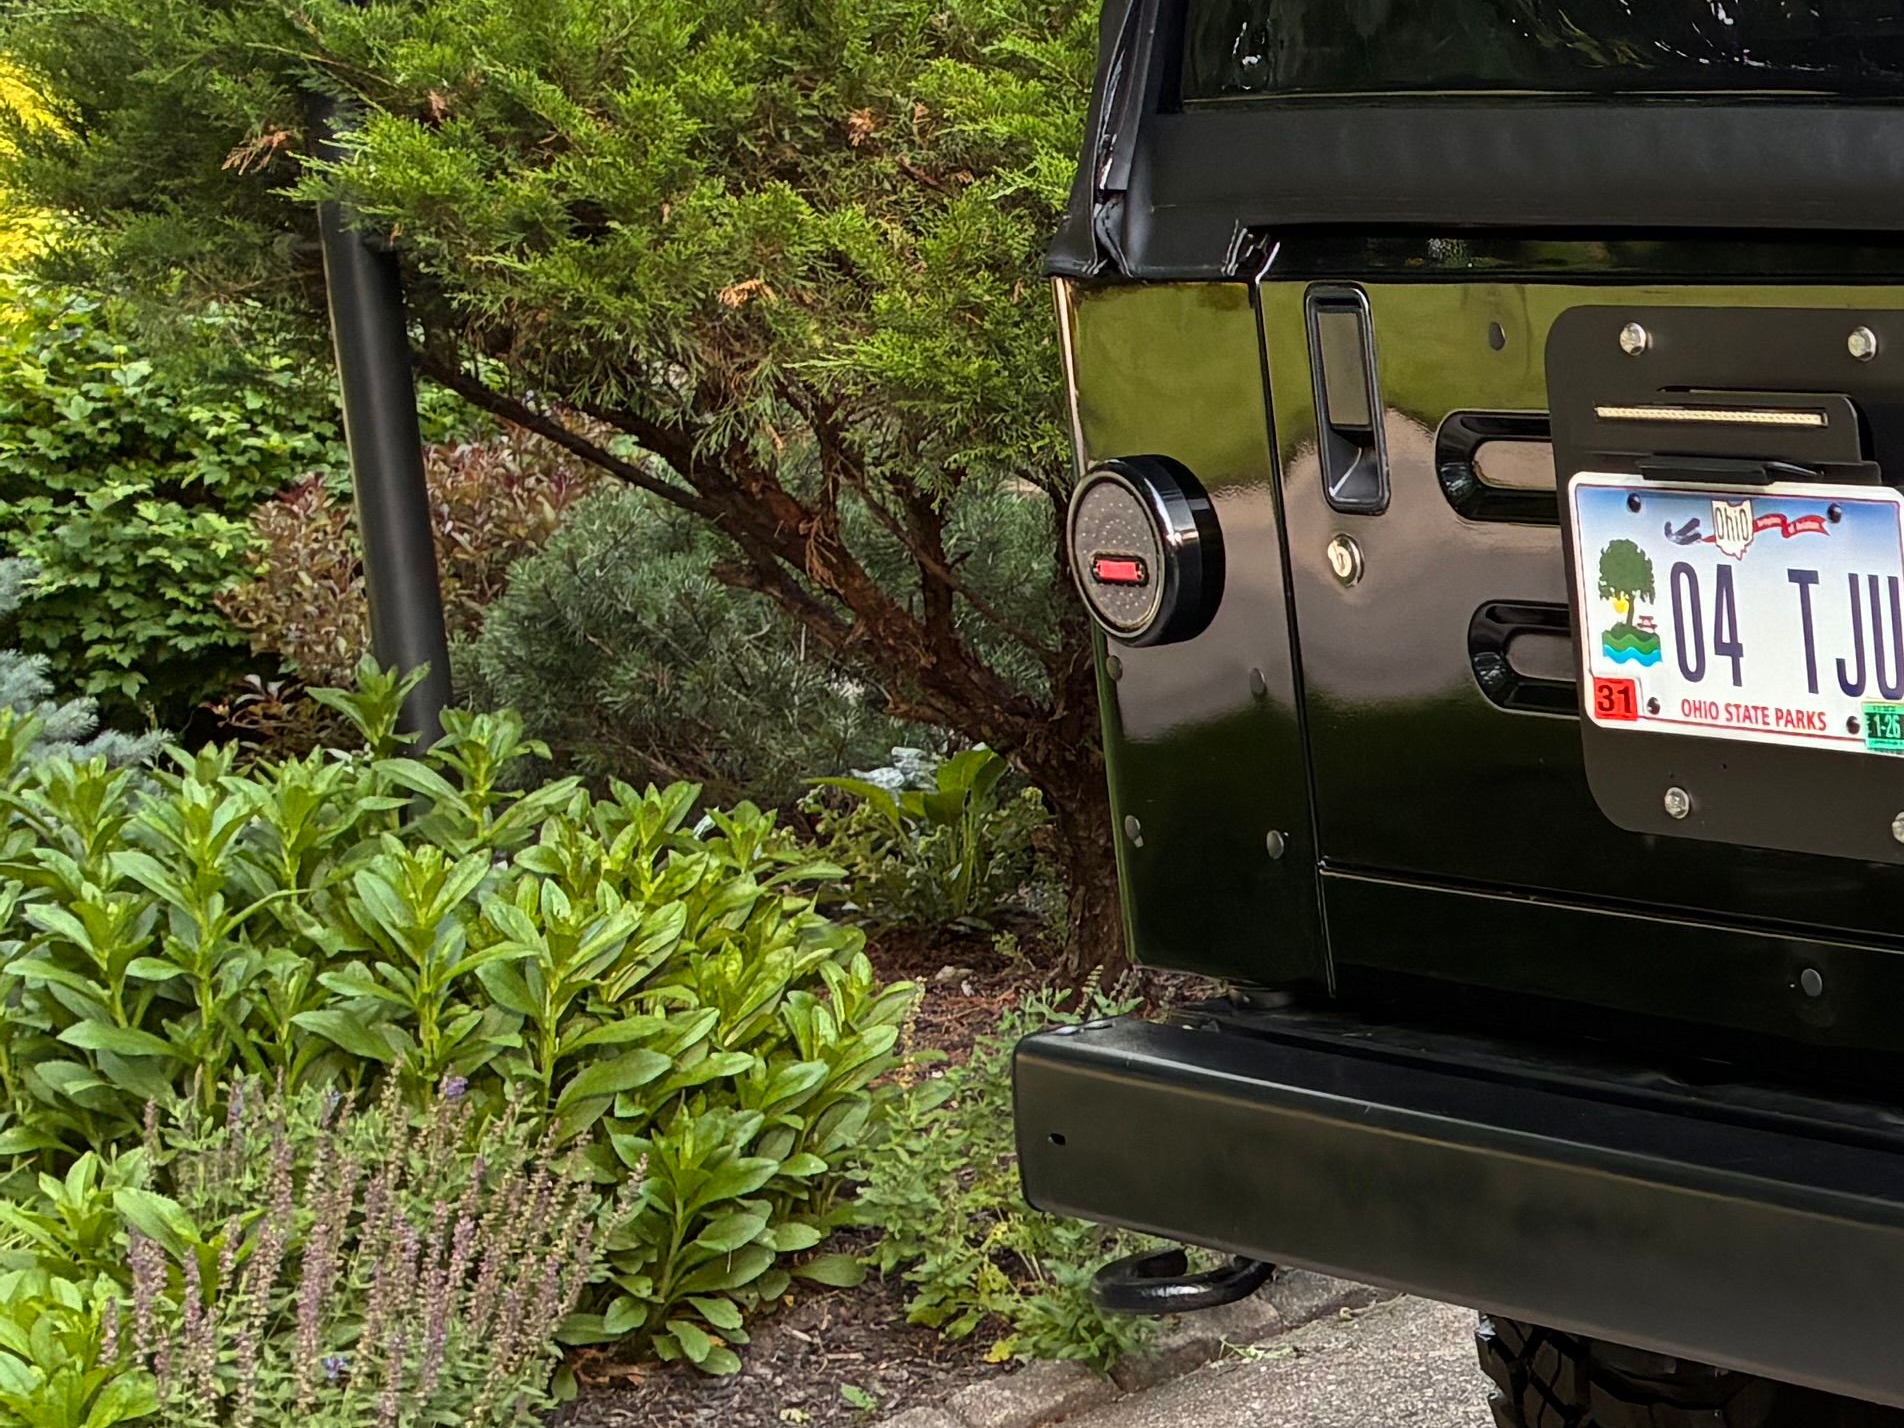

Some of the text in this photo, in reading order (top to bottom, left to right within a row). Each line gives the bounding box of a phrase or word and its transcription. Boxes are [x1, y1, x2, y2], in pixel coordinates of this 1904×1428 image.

[1670, 561, 1745, 687] 04
[1597, 684, 1632, 714] 31
[1681, 698, 1827, 731] OHIO STATE PARKS
